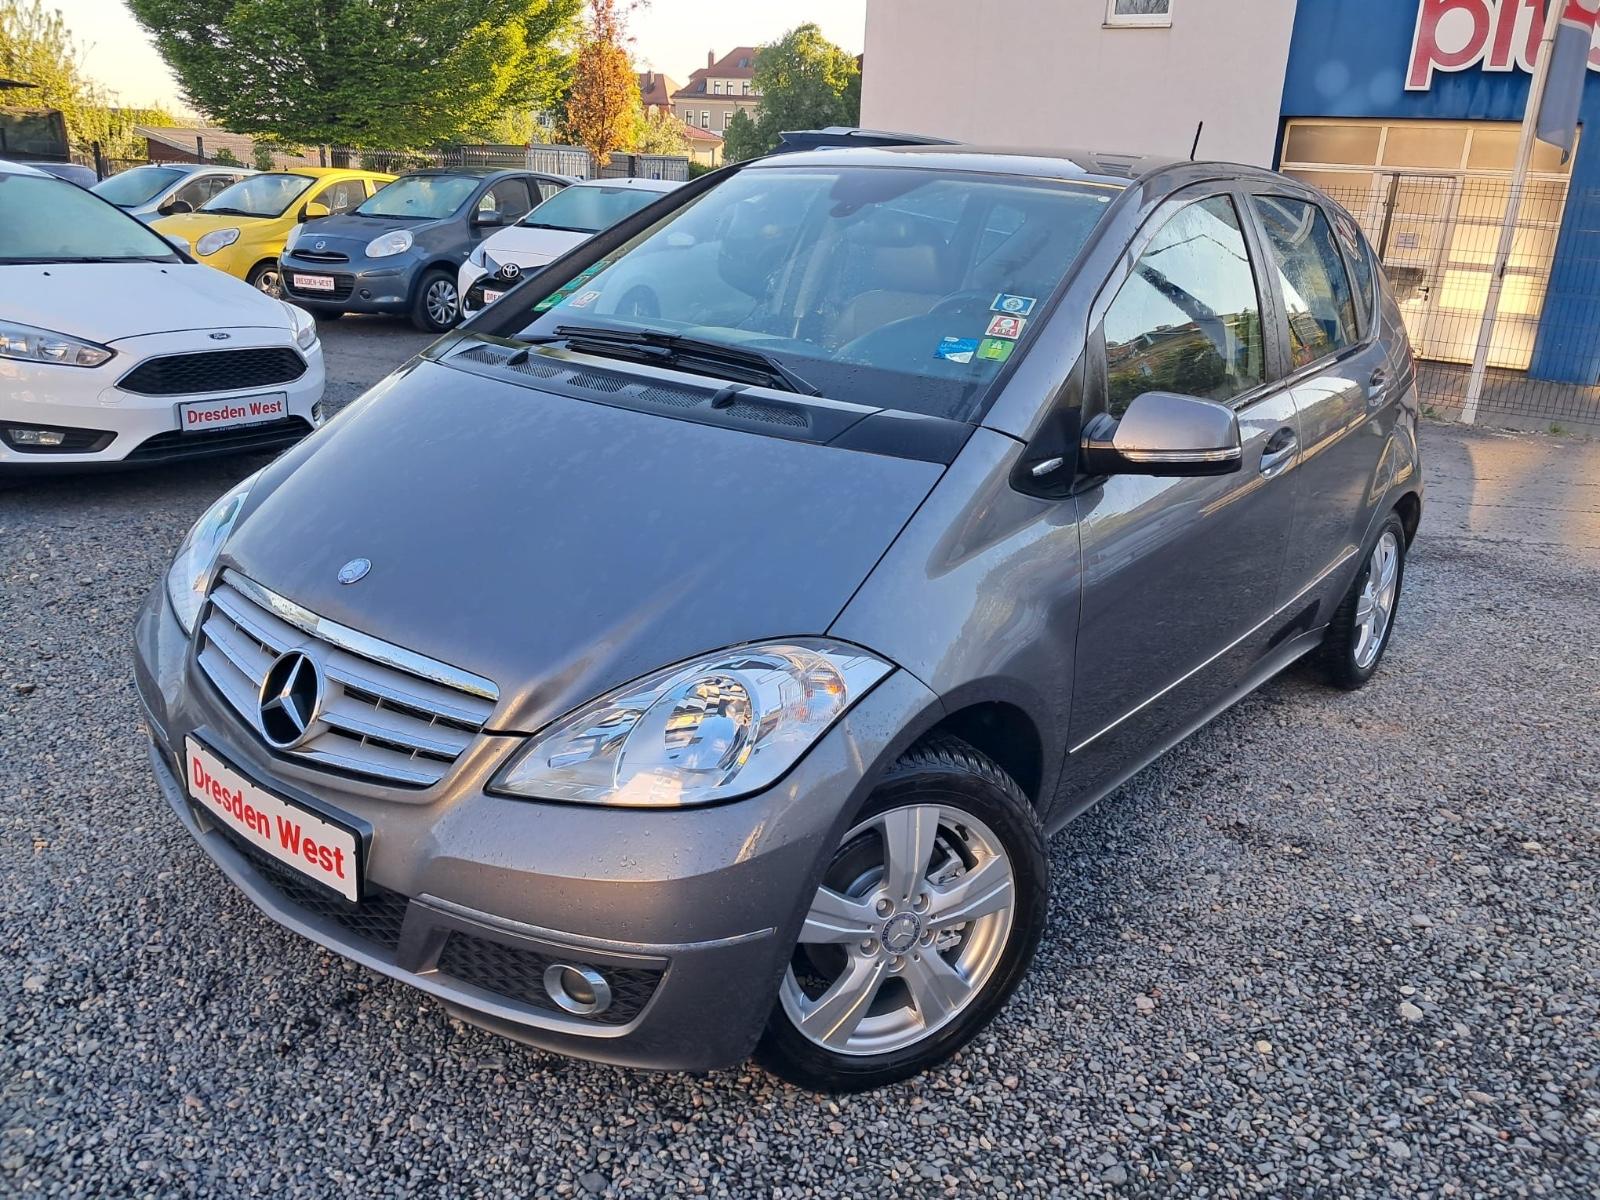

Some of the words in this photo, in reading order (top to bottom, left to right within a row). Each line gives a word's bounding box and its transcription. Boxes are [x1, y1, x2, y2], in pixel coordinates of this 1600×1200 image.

[187, 405, 246, 424] Dresden
[249, 400, 282, 416] West
[192, 756, 271, 840] Dresden
[276, 815, 345, 880] West
